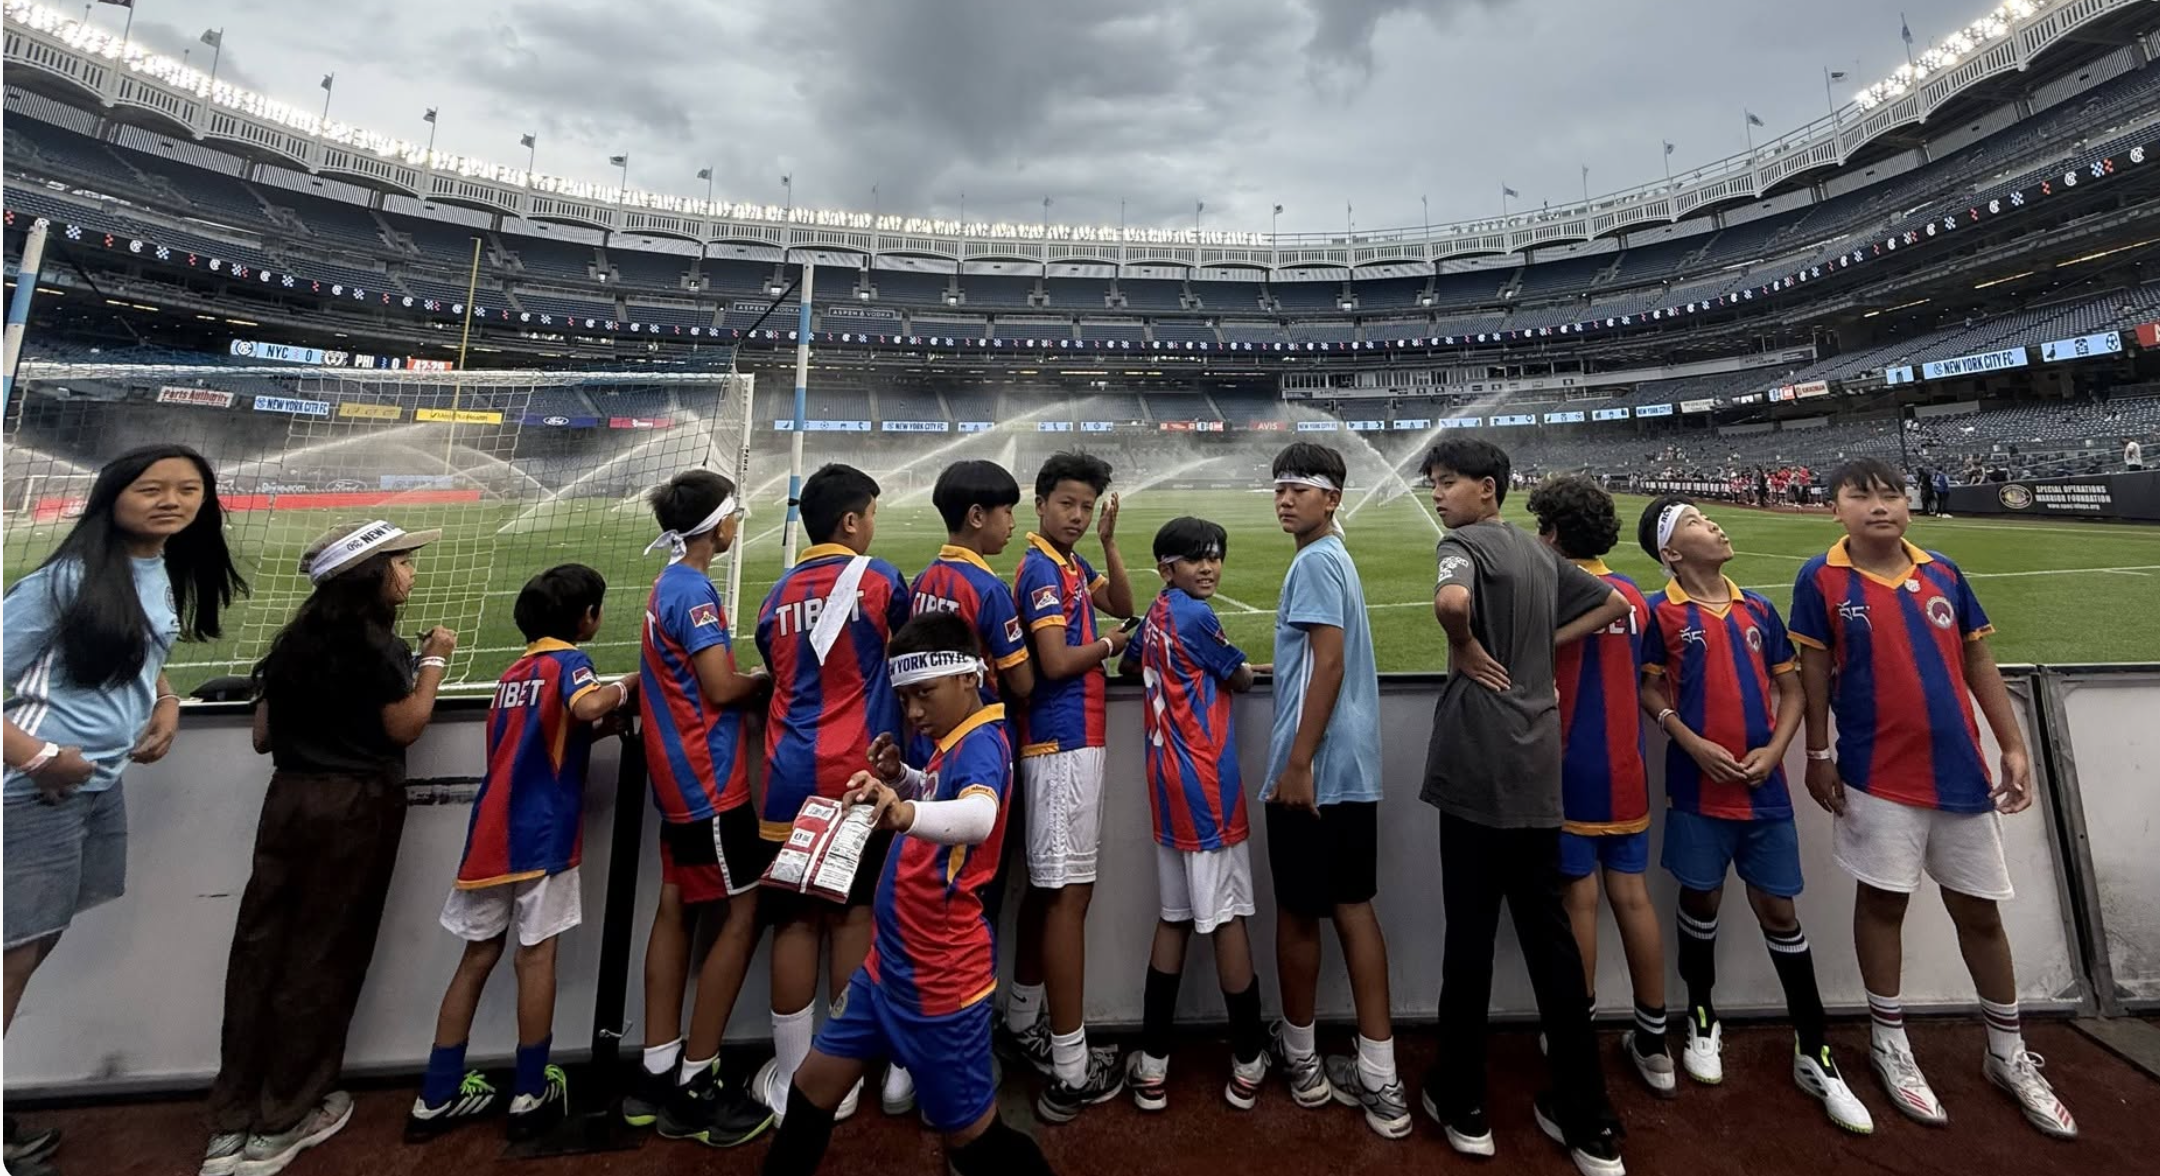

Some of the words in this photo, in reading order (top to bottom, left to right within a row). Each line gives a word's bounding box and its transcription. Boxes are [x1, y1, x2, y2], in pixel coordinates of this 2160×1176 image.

[266, 345, 288, 359] NYC
[305, 350, 312, 362] 0
[354, 353, 375, 369] PHI
[391, 357, 400, 370] 0
[1944, 359, 1962, 375] NEW
[1962, 356, 1983, 372] YORK
[1983, 354, 2002, 369] CITY
[2002, 351, 2014, 366] FC
[162, 388, 188, 400] Parts
[189, 390, 229, 404] Authority
[267, 398, 285, 410] NEW
[285, 400, 303, 412] YORK
[304, 401, 319, 413] CITY
[319, 402, 328, 414] FC
[895, 422, 909, 430] NEW
[909, 422, 924, 430] YORK
[925, 422, 936, 430] CITY
[936, 422, 944, 430] FC
[1257, 422, 1278, 430] AVIS
[360, 525, 385, 544] NEW
[775, 590, 865, 637] TIBT
[897, 653, 929, 674] YORK
[930, 652, 955, 668] CITY
